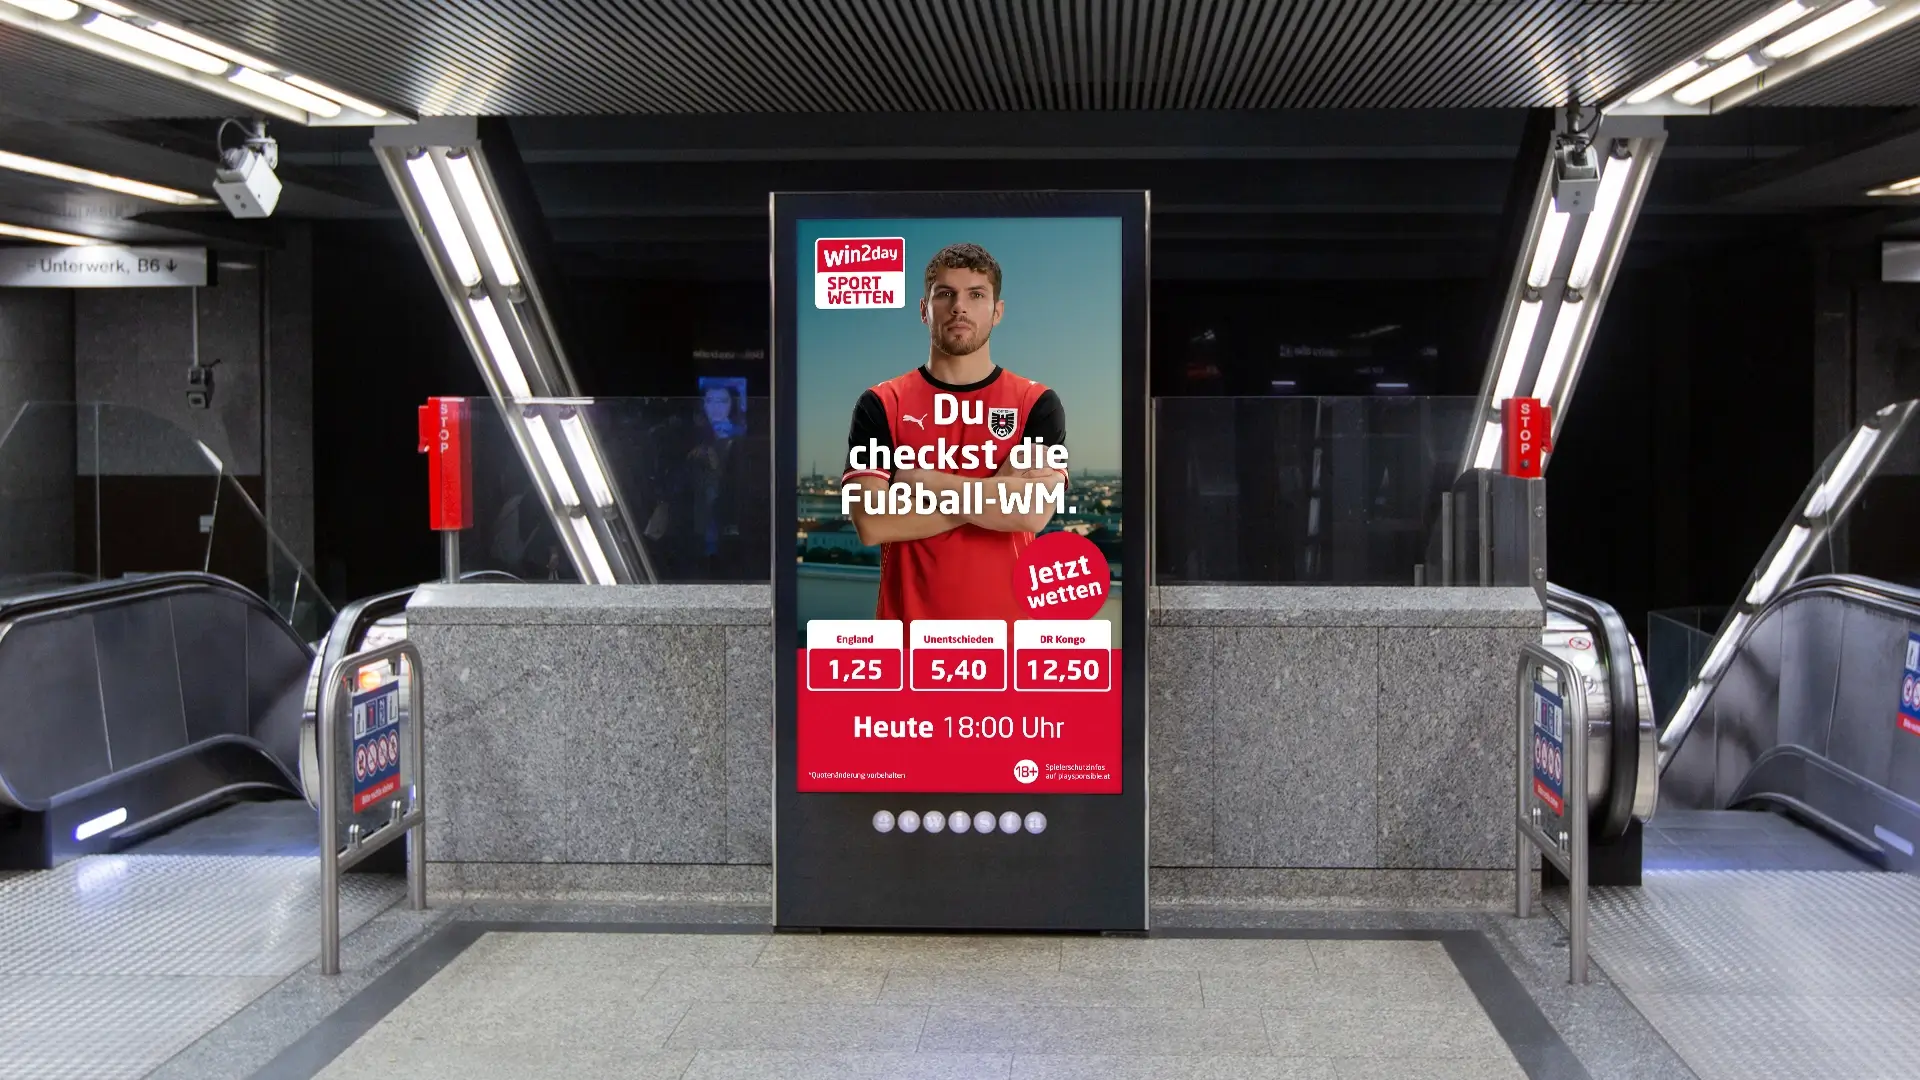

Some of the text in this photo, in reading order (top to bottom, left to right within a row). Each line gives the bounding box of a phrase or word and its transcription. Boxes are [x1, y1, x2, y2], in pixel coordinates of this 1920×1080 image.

[40, 258, 130, 274] Unterwerk,
[138, 258, 160, 273] B6
[823, 244, 898, 268] win2day
[827, 276, 882, 290] SPORT
[827, 290, 894, 304] WETTEN
[934, 393, 984, 425] Du
[440, 403, 450, 454] STOP
[1520, 403, 1531, 455] STOP
[850, 436, 1069, 470] checkst die
[841, 482, 1077, 515] Fußball-WM.
[1029, 555, 1091, 591] Jetzt
[1027, 581, 1102, 609] wetten
[836, 635, 874, 645] England
[923, 635, 994, 645] Unentschieden
[1040, 635, 1086, 645] DR Kongo
[829, 659, 882, 682] 1,25
[931, 659, 987, 682] 5,40
[1027, 659, 1100, 682] 12,50
[854, 716, 1065, 739] Heute 18:00 Uhr
[867, 771, 906, 779] vorbehalten
[1015, 765, 1038, 778] 18+
[1045, 763, 1106, 772] Spielerschutzinfos
